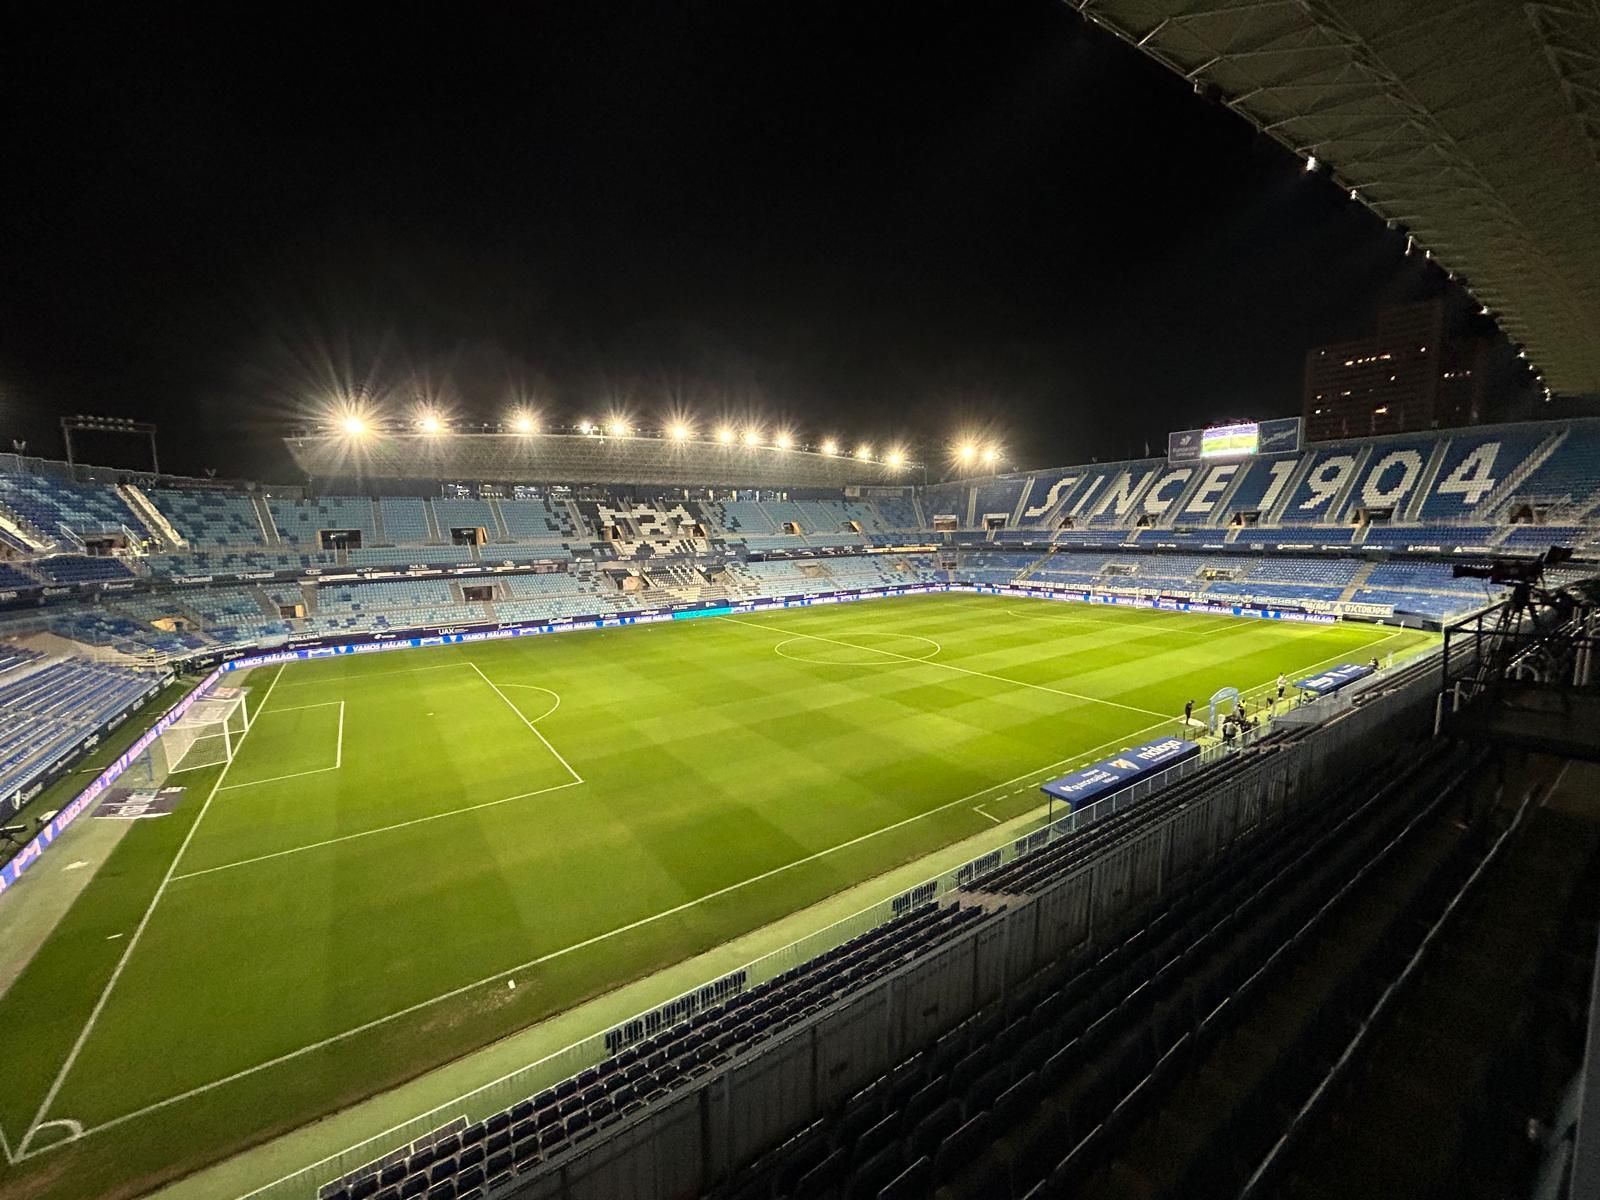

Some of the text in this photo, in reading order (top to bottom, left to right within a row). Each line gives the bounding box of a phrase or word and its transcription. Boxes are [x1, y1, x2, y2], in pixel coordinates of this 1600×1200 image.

[1025, 442, 1501, 517] SINCE 1904
[1280, 611, 1335, 623] VAMOS MÁLAGA
[438, 627, 455, 635] UAX
[462, 629, 513, 641] VAMOS MÁLAGA
[352, 639, 413, 653] VAMOS MÁLAGA
[235, 652, 299, 669] VAMOS MÁLAGA
[1136, 739, 1183, 759] málaga
